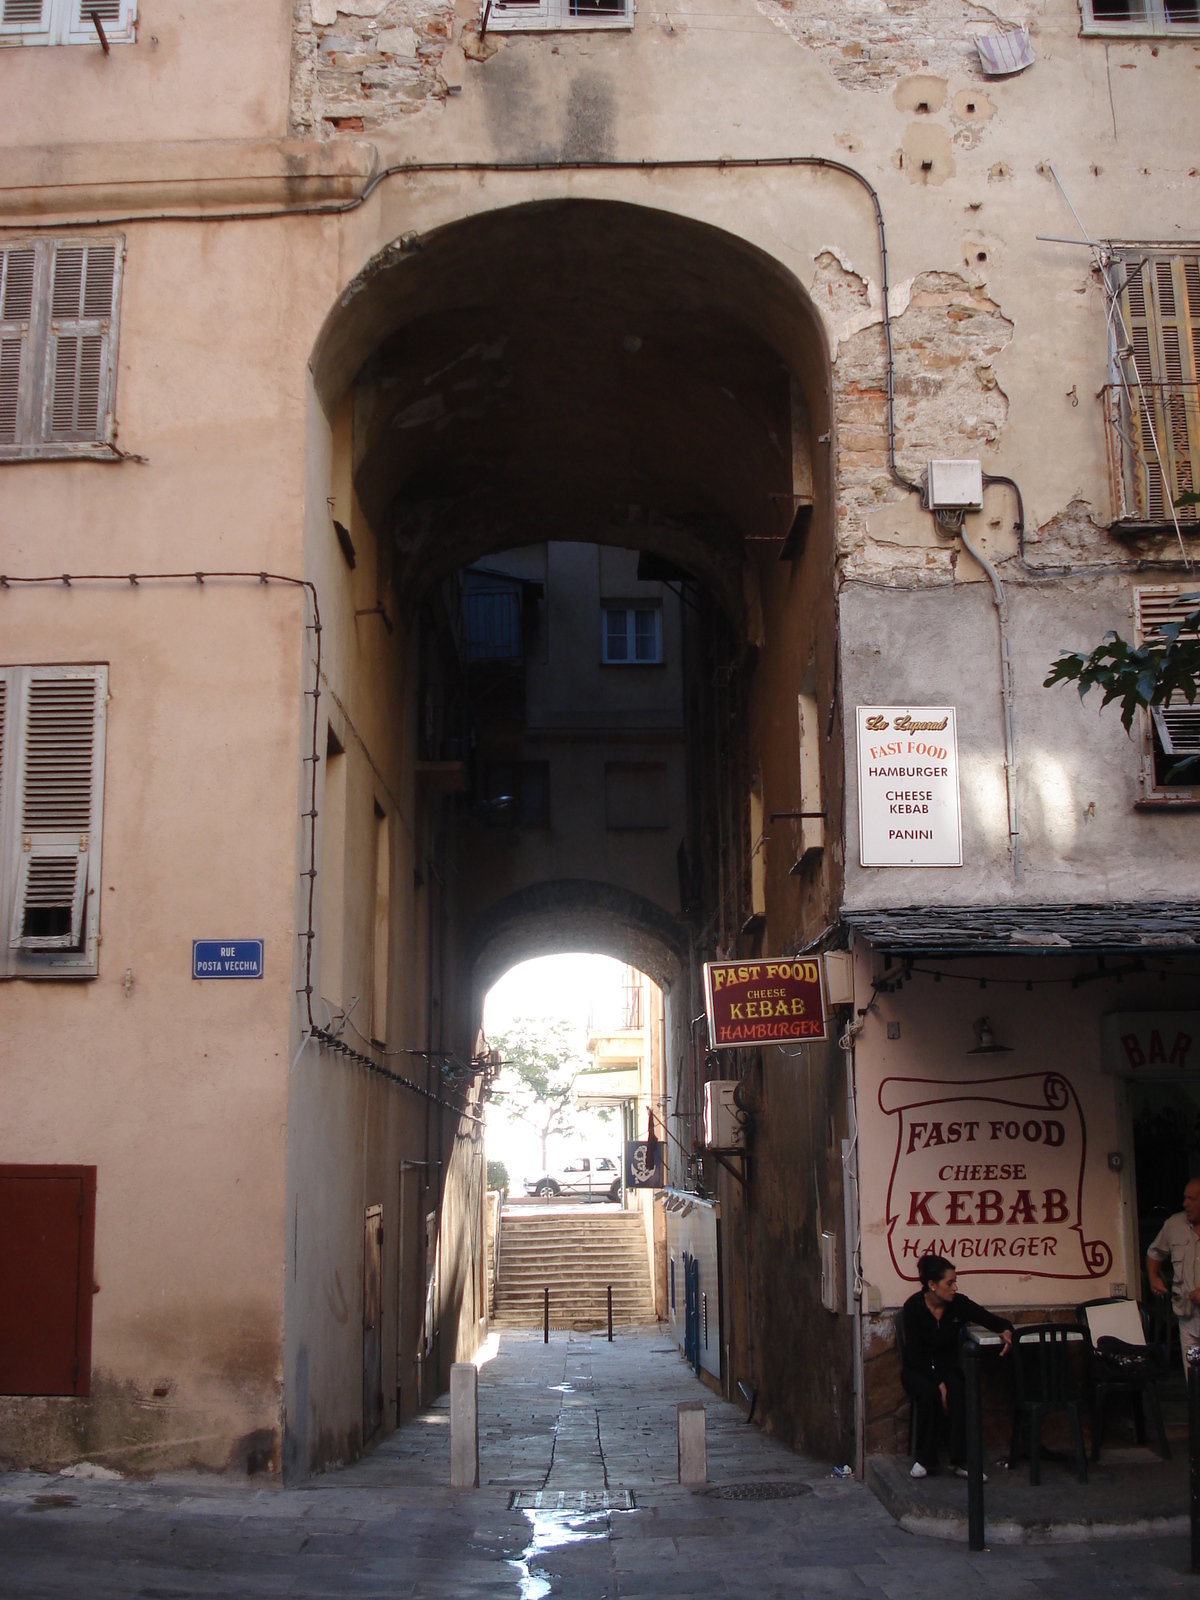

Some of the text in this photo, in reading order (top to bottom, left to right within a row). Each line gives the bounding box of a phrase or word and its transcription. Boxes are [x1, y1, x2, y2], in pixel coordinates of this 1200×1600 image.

[870, 741, 948, 760] FAST FOOD
[869, 767, 948, 777] HAMBURGER
[885, 791, 933, 801] CHEESE
[889, 804, 929, 814] KEBAB
[889, 829, 933, 840] PANINI
[220, 946, 236, 957] RUE
[197, 961, 258, 971] POSTA VECCHIA
[713, 962, 818, 992] FAST FOOD
[747, 988, 787, 999] CHEESE
[730, 998, 805, 1020] KEBAB
[720, 1020, 820, 1041] HAMBURGER
[1121, 1029, 1192, 1069] BAR
[906, 1119, 1066, 1155] FAST FOOD
[938, 1163, 1027, 1181] CHEESE
[906, 1188, 1070, 1227] KEBAB
[902, 1236, 1058, 1258] HAMBURGER
